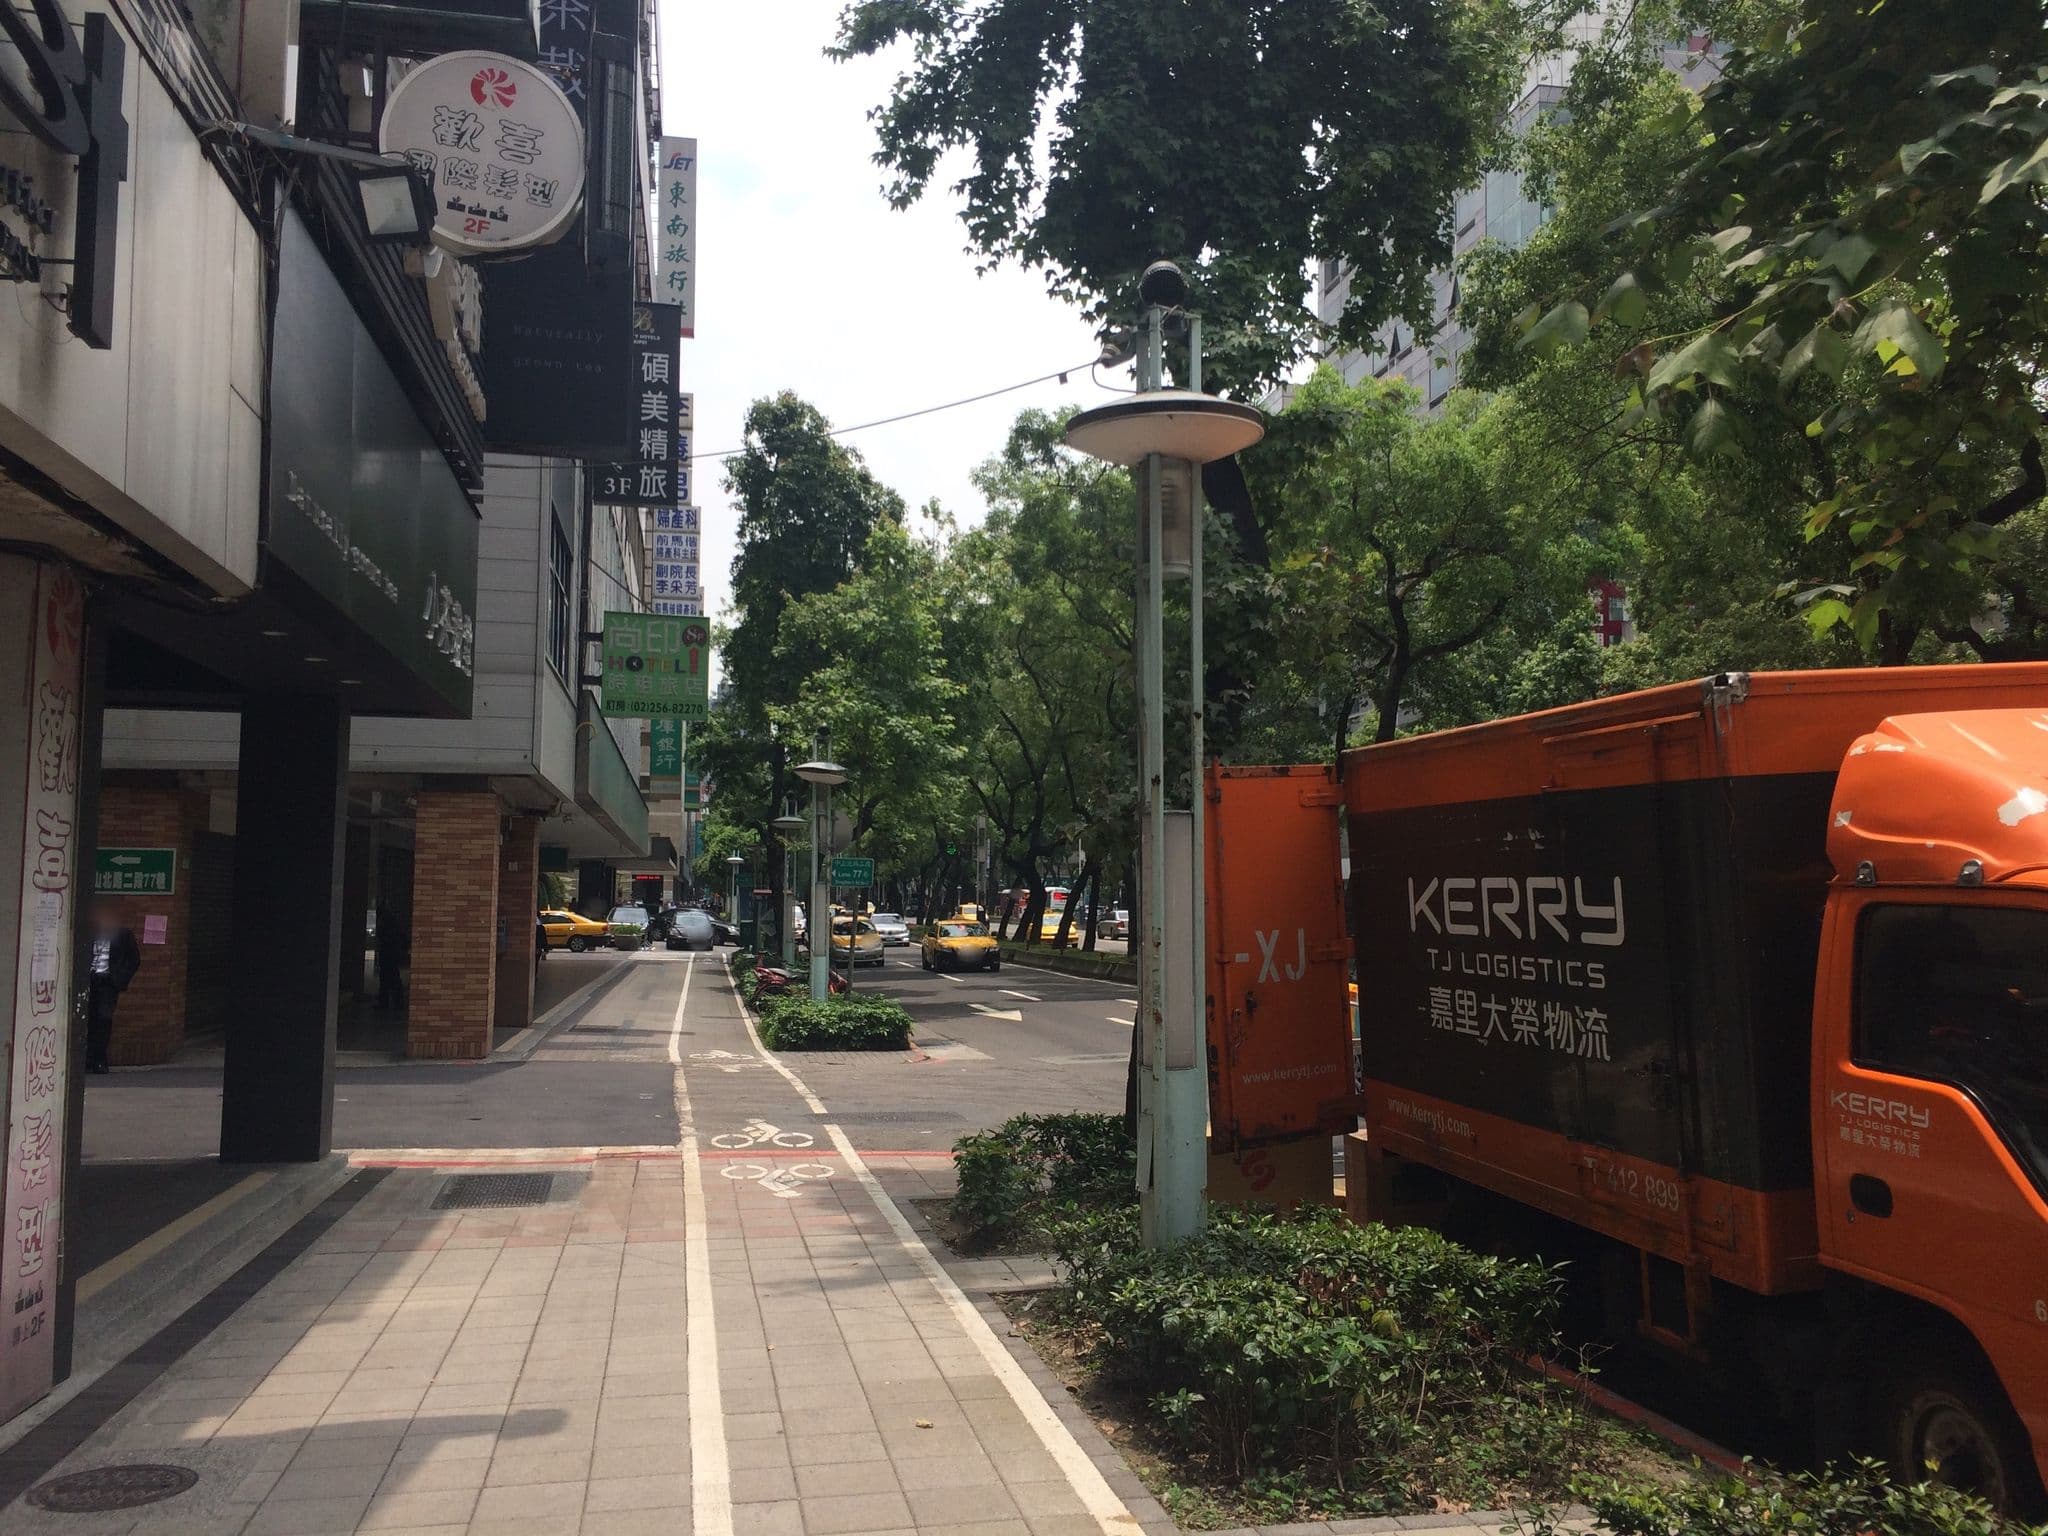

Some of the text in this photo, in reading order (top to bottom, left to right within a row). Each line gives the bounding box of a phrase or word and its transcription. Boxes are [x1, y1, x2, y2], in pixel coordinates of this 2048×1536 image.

[663, 152, 694, 172] JET
[464, 217, 491, 234] 2F
[639, 351, 671, 499] 碩美精旅
[604, 477, 632, 496] 3F
[657, 509, 698, 529] 婦產科
[655, 564, 697, 580] 副院長
[1408, 876, 1625, 945] KERRY
[1426, 948, 1606, 988] TJ LOGISTICS
[1429, 986, 1611, 1061] 嘉里大榮物流
[1242, 1063, 1337, 1084] www.kerrytj.com
[1387, 1097, 1471, 1138] www.kerrytj.com
[1830, 1090, 1930, 1128] KERRY
[1857, 1118, 1920, 1140] LOGISTICS
